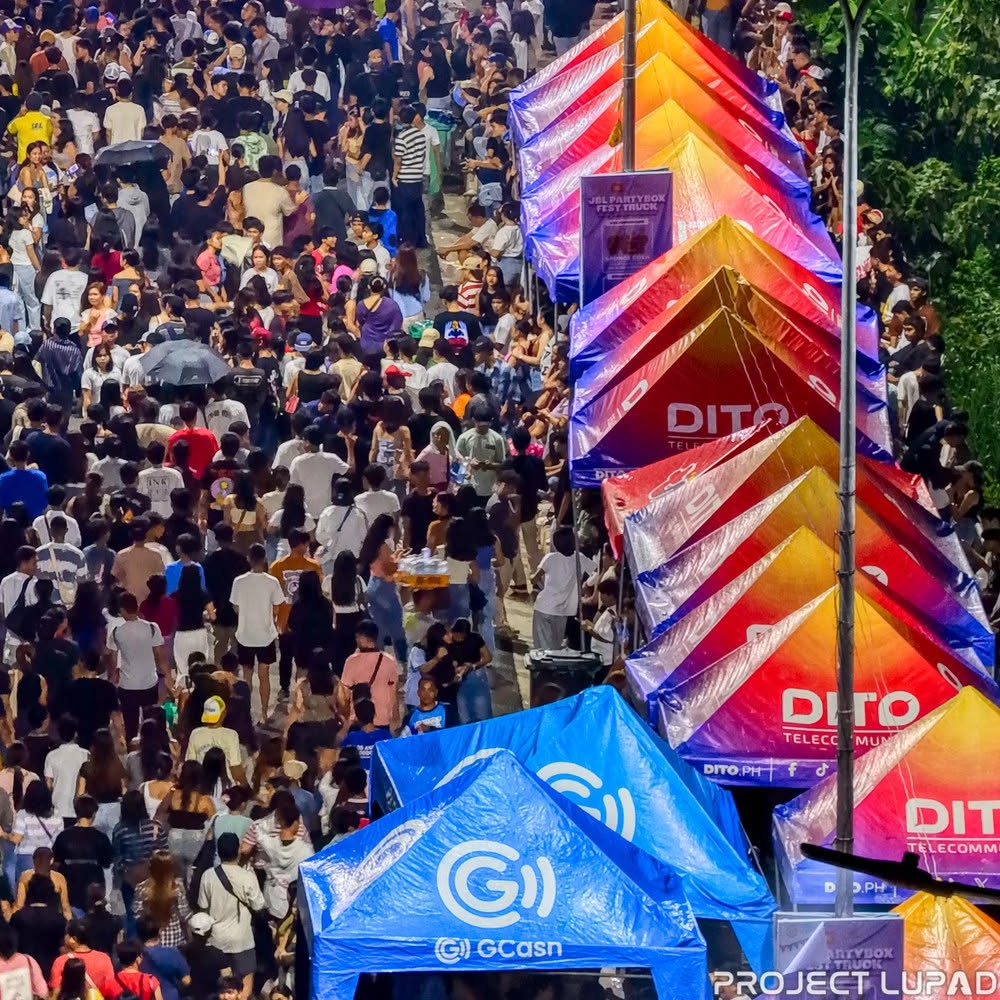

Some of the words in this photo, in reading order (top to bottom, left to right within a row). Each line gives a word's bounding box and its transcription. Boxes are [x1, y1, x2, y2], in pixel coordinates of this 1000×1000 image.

[596, 204, 621, 213] FEST
[623, 202, 658, 212] TRUCK
[609, 193, 666, 204] PARTYBOX
[668, 403, 789, 434] DITO
[782, 688, 920, 726] DITO
[703, 763, 761, 777] DITO.PH
[906, 798, 1000, 835] DIT
